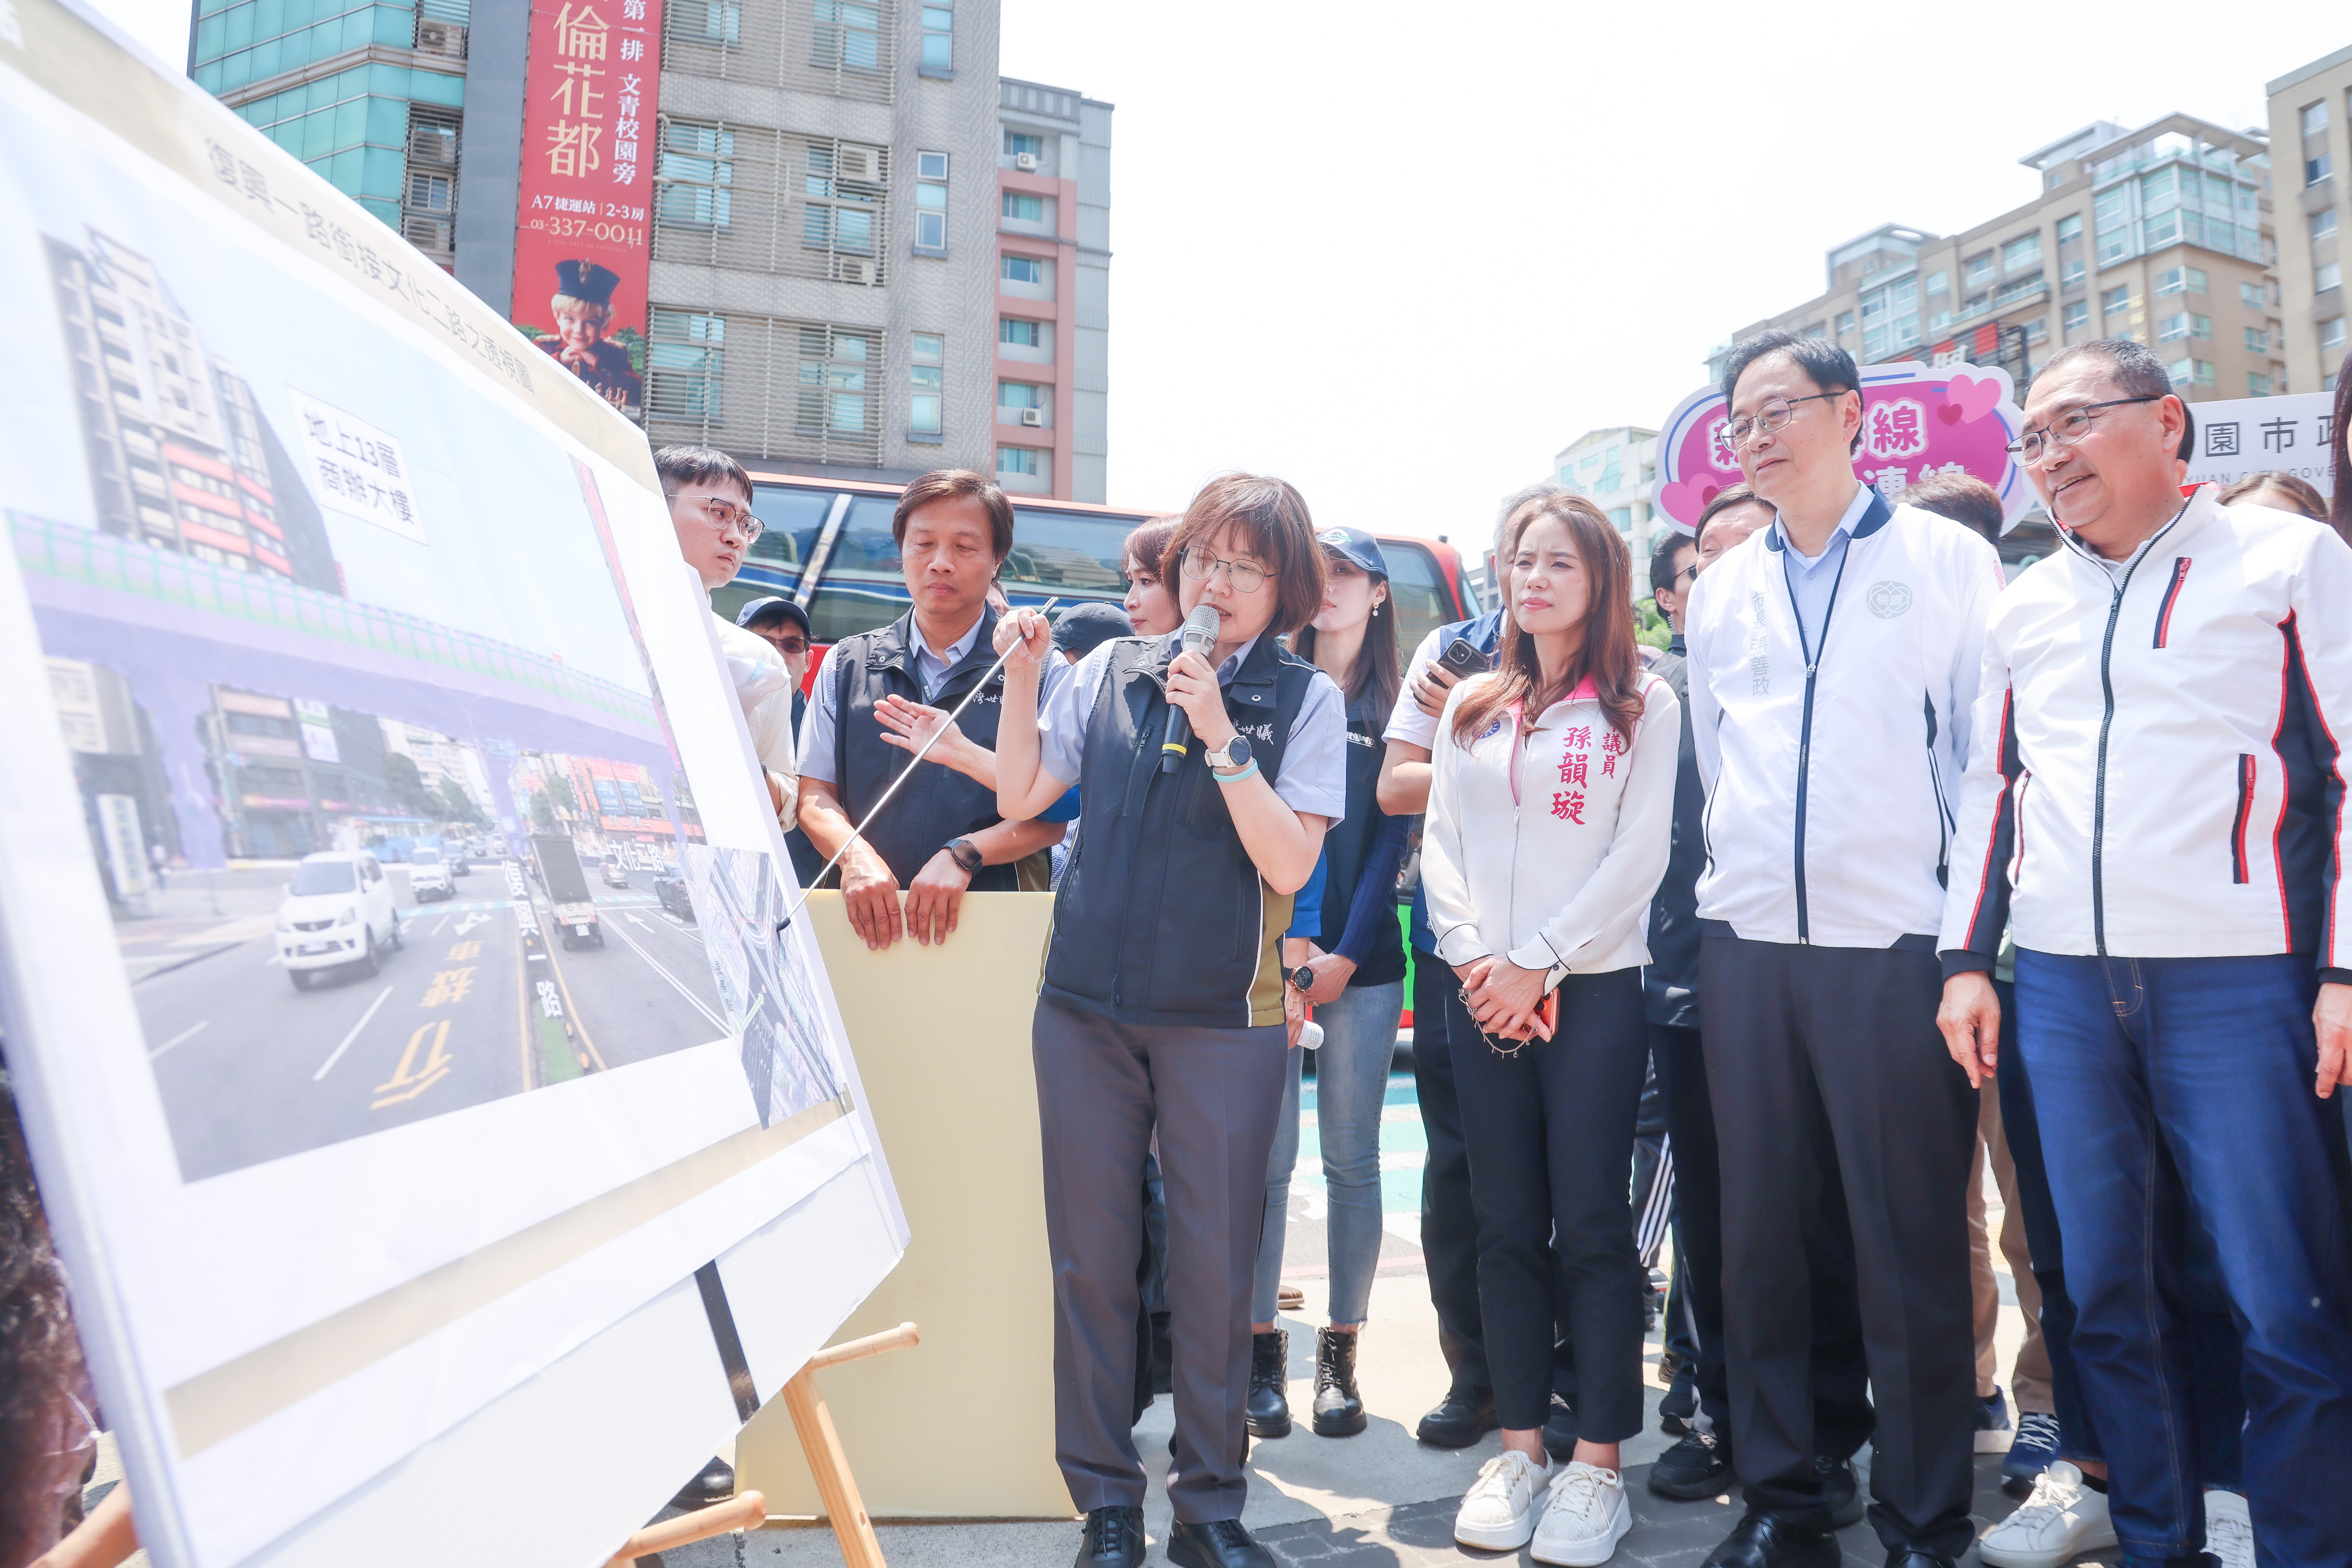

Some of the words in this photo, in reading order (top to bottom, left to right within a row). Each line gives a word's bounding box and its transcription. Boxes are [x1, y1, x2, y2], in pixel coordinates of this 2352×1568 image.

[546, 2, 610, 178] 倫花都
[1876, 593, 1903, 606] 桃園
[1550, 725, 1593, 826] 孫韻璇
[1600, 726, 1622, 779] 議員
[610, 840, 666, 872] 文化二路
[501, 860, 564, 1018] 復興一路
